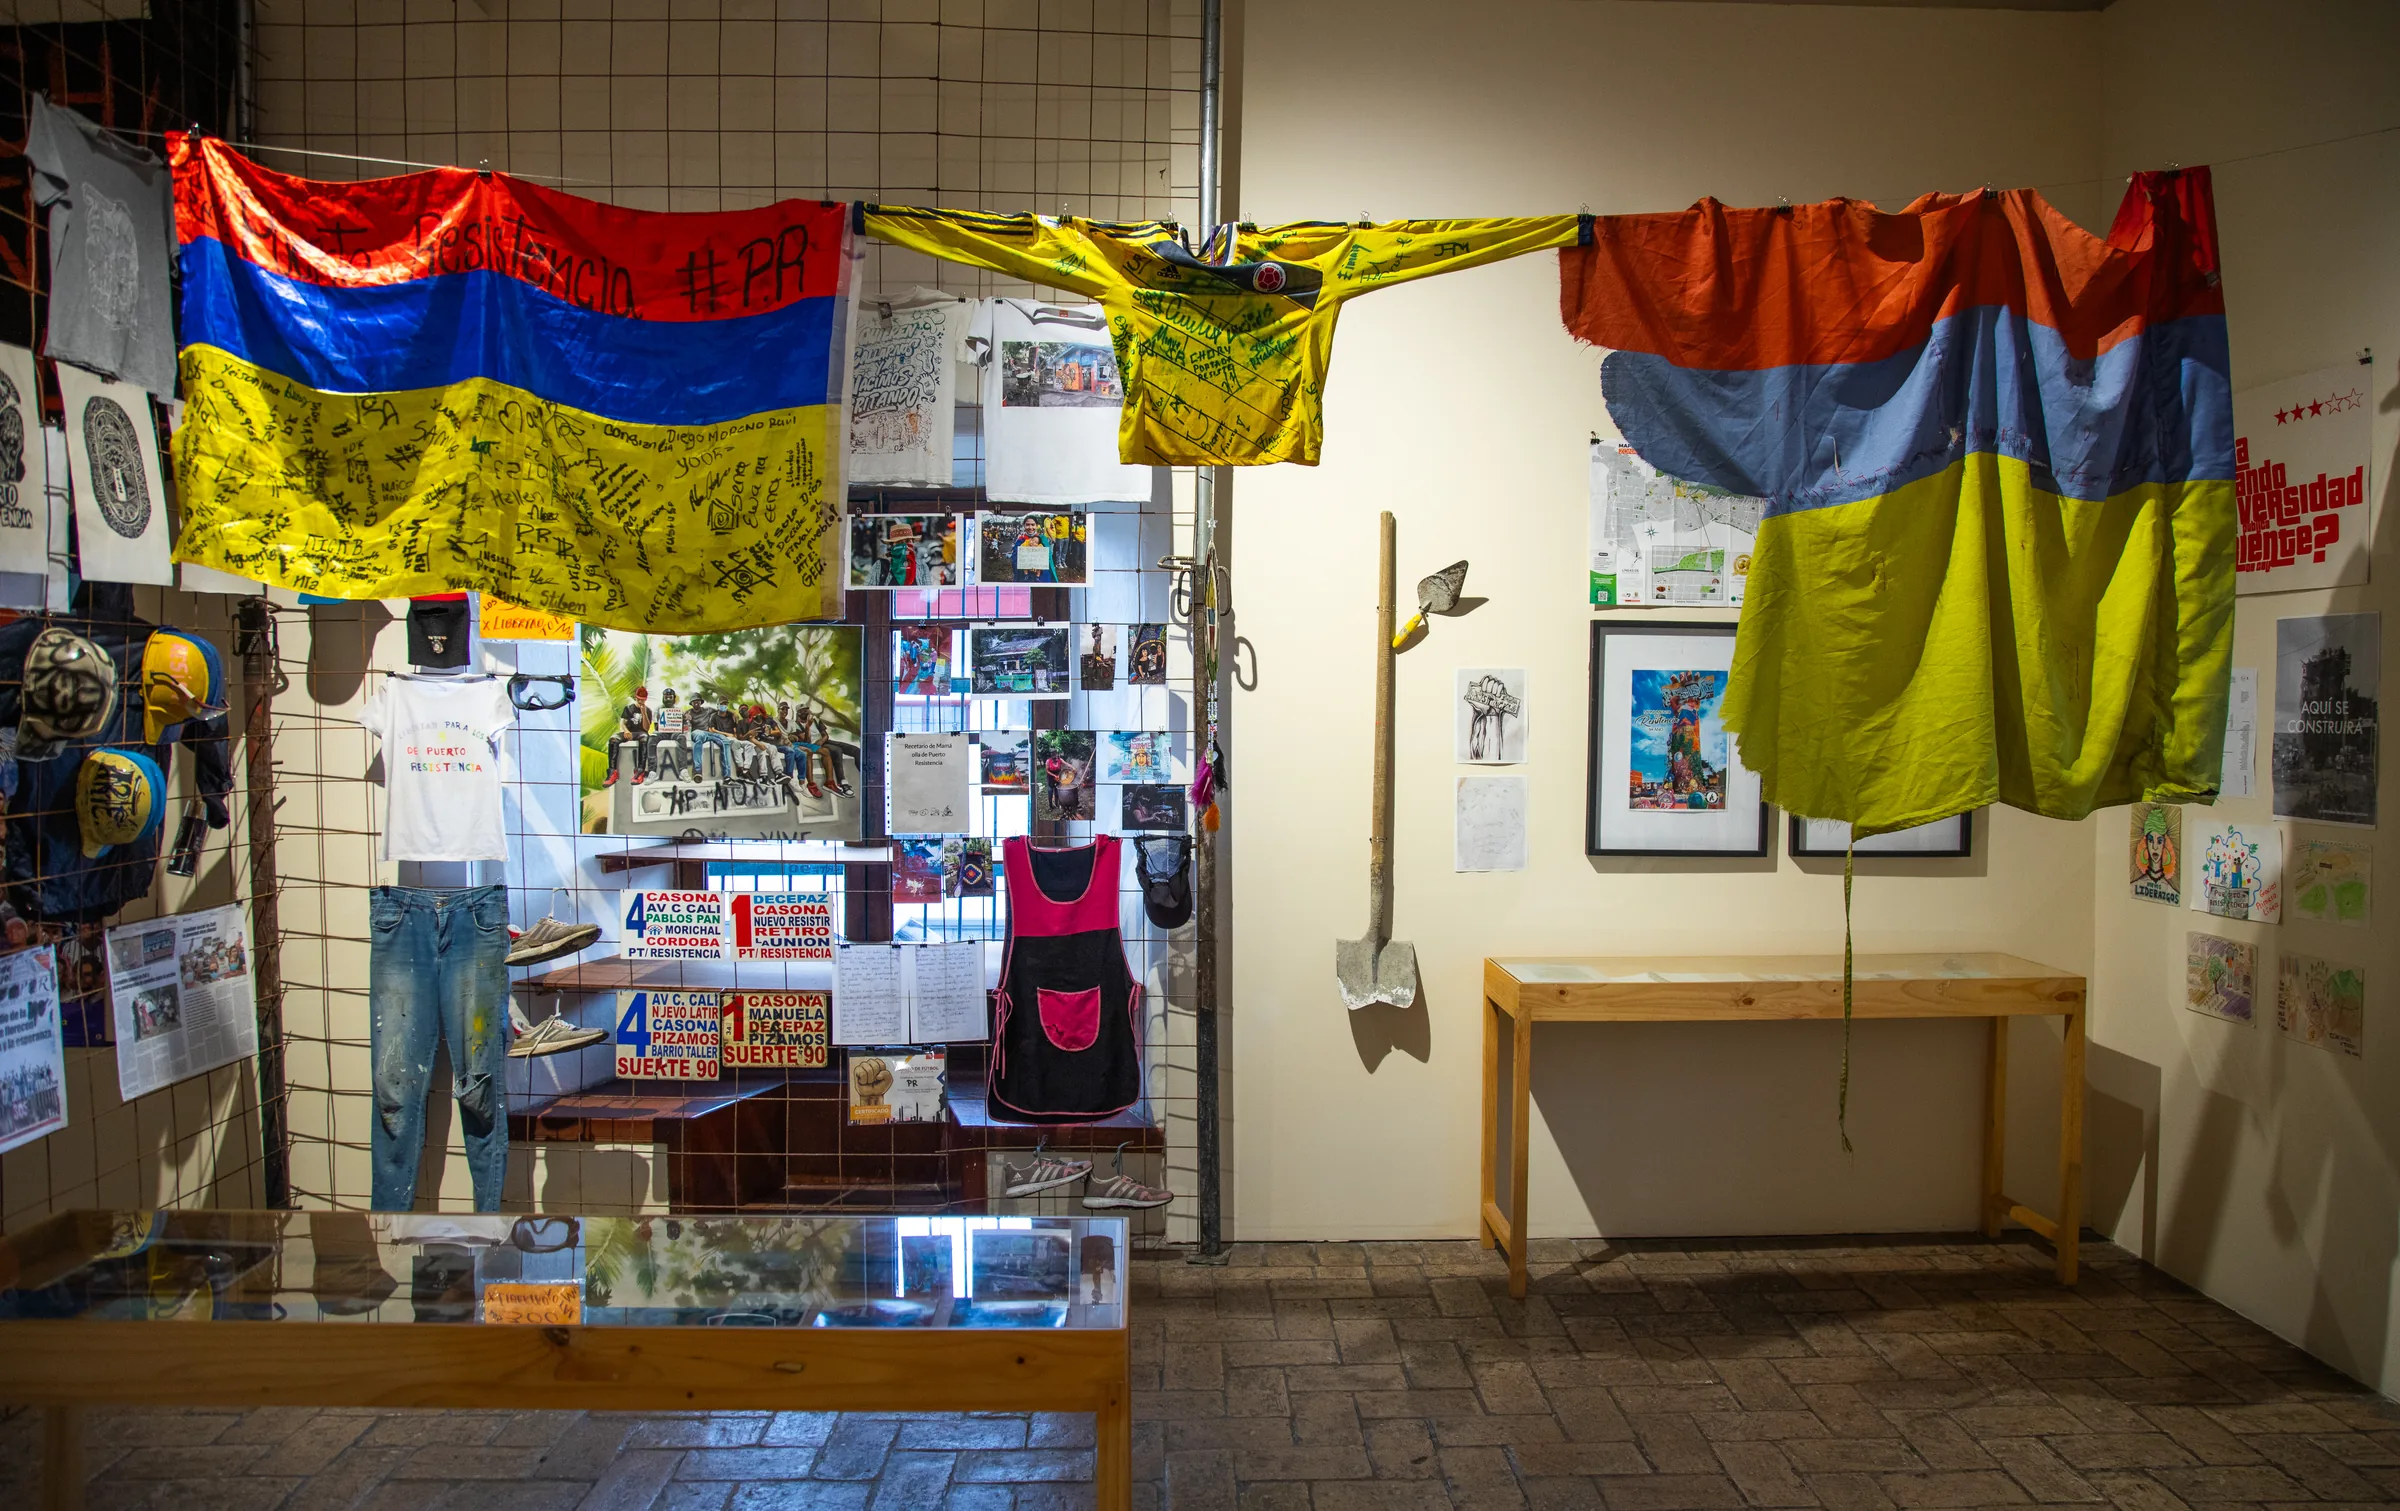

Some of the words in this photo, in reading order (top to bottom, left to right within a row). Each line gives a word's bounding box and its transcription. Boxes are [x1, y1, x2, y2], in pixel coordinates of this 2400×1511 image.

[1157, 271, 1181, 280] adidas
[853, 386, 920, 414] RITANDO
[2236, 459, 2287, 497] ando
[2237, 466, 2363, 526] versidad
[493, 616, 543, 630] LIBERTAD
[2301, 697, 2334, 715] AQUÍ
[2335, 701, 2349, 715] SE
[445, 721, 468, 732] PARA
[472, 728, 484, 742] LOS
[2287, 717, 2363, 735] CONSTRUIRÁ
[407, 746, 418, 755] DE
[427, 747, 466, 756] PUERTO
[411, 762, 482, 772] RESISTENCIA
[646, 893, 720, 902] CASONA
[753, 894, 829, 904] DECEPAZ
[646, 904, 666, 913] AV
[671, 904, 681, 913] C
[687, 904, 720, 914] CALI
[753, 905, 829, 914] CASONA
[626, 893, 646, 938] 4
[646, 914, 693, 924] PABLOS
[697, 914, 720, 924] PAN
[731, 894, 752, 947] 1
[754, 916, 785, 926] NUEVO
[788, 916, 830, 926] RESISTIR
[665, 925, 721, 935] MORICHAL
[755, 927, 829, 936] RETIRO
[646, 937, 720, 947] CORDOBA
[770, 938, 830, 946] UNION
[628, 948, 648, 958] PT/
[651, 948, 721, 958] RESISTENCIA
[739, 948, 759, 958] PT/
[762, 948, 832, 958] RESISTENCIA
[652, 994, 669, 1005] AV
[673, 994, 685, 1005] C.
[689, 994, 718, 1006] CALI
[748, 995, 823, 1007] CASONA
[690, 1007, 718, 1019] LATIR
[723, 996, 744, 1041] 1
[750, 1008, 824, 1020] MANUELA
[617, 993, 651, 1057] 4
[653, 1019, 718, 1032] CASONA
[750, 1021, 824, 1033] DECEPAZ
[653, 1032, 719, 1045] PIZAMOS
[750, 1034, 825, 1045] PIZAMOS
[652, 1045, 683, 1058] BARRIO
[686, 1046, 718, 1058] TALLER
[724, 1046, 797, 1063] SUERTE
[805, 1046, 825, 1063] 90
[617, 1057, 690, 1076] SUERTE
[697, 1060, 718, 1078] 90
